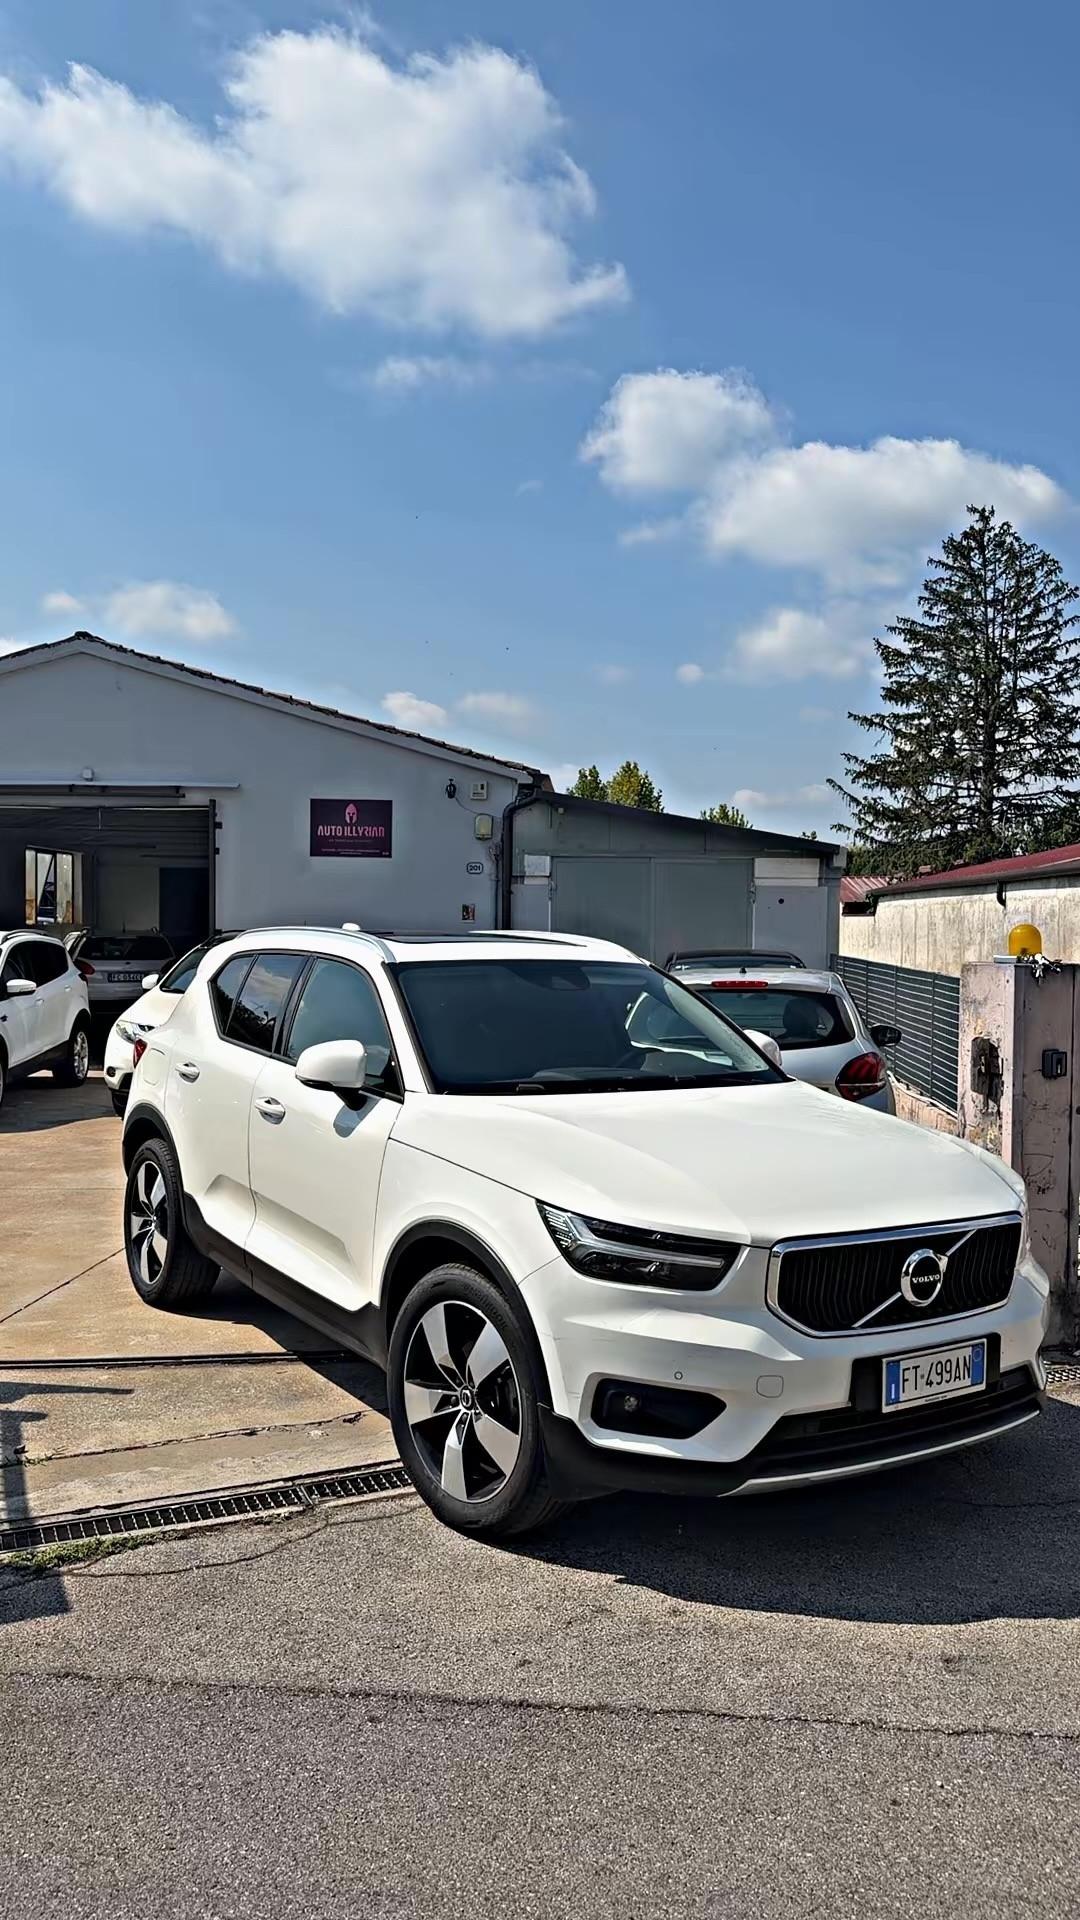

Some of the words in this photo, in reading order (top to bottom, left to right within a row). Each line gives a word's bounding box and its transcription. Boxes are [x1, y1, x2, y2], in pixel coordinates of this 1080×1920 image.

[317, 825, 343, 837] AUTO
[344, 826, 385, 838] ILLYRIAN
[469, 864, 481, 872] 201
[912, 1273, 940, 1283] VOLVO
